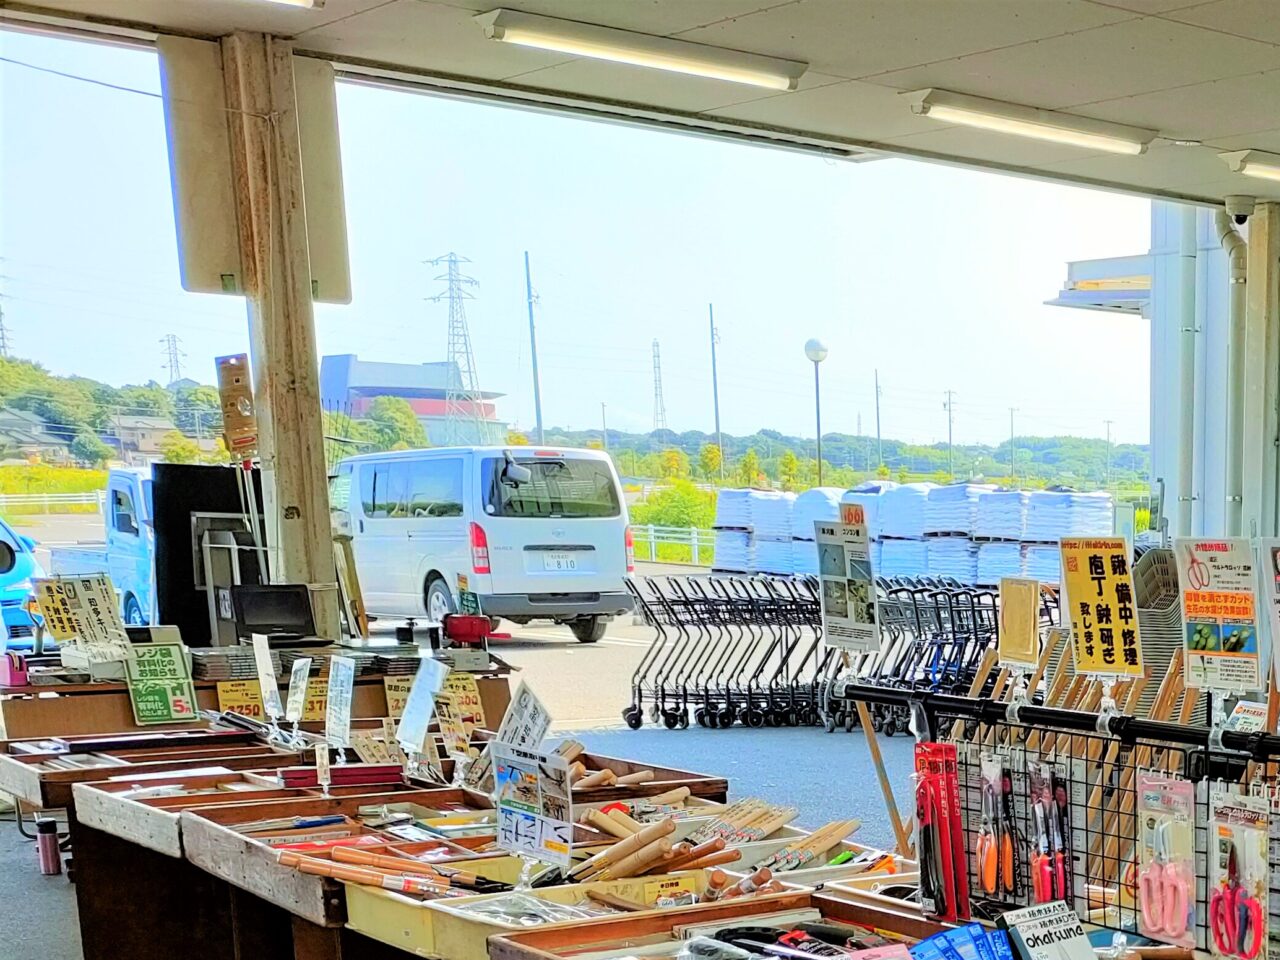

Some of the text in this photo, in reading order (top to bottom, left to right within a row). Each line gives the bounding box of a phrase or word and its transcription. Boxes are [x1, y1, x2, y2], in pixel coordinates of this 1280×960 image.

[135, 648, 172, 658] レジ袋
[136, 660, 175, 668] 有料化の
[138, 668, 177, 677] お知らせ
[1026, 925, 1084, 948] okatsune
